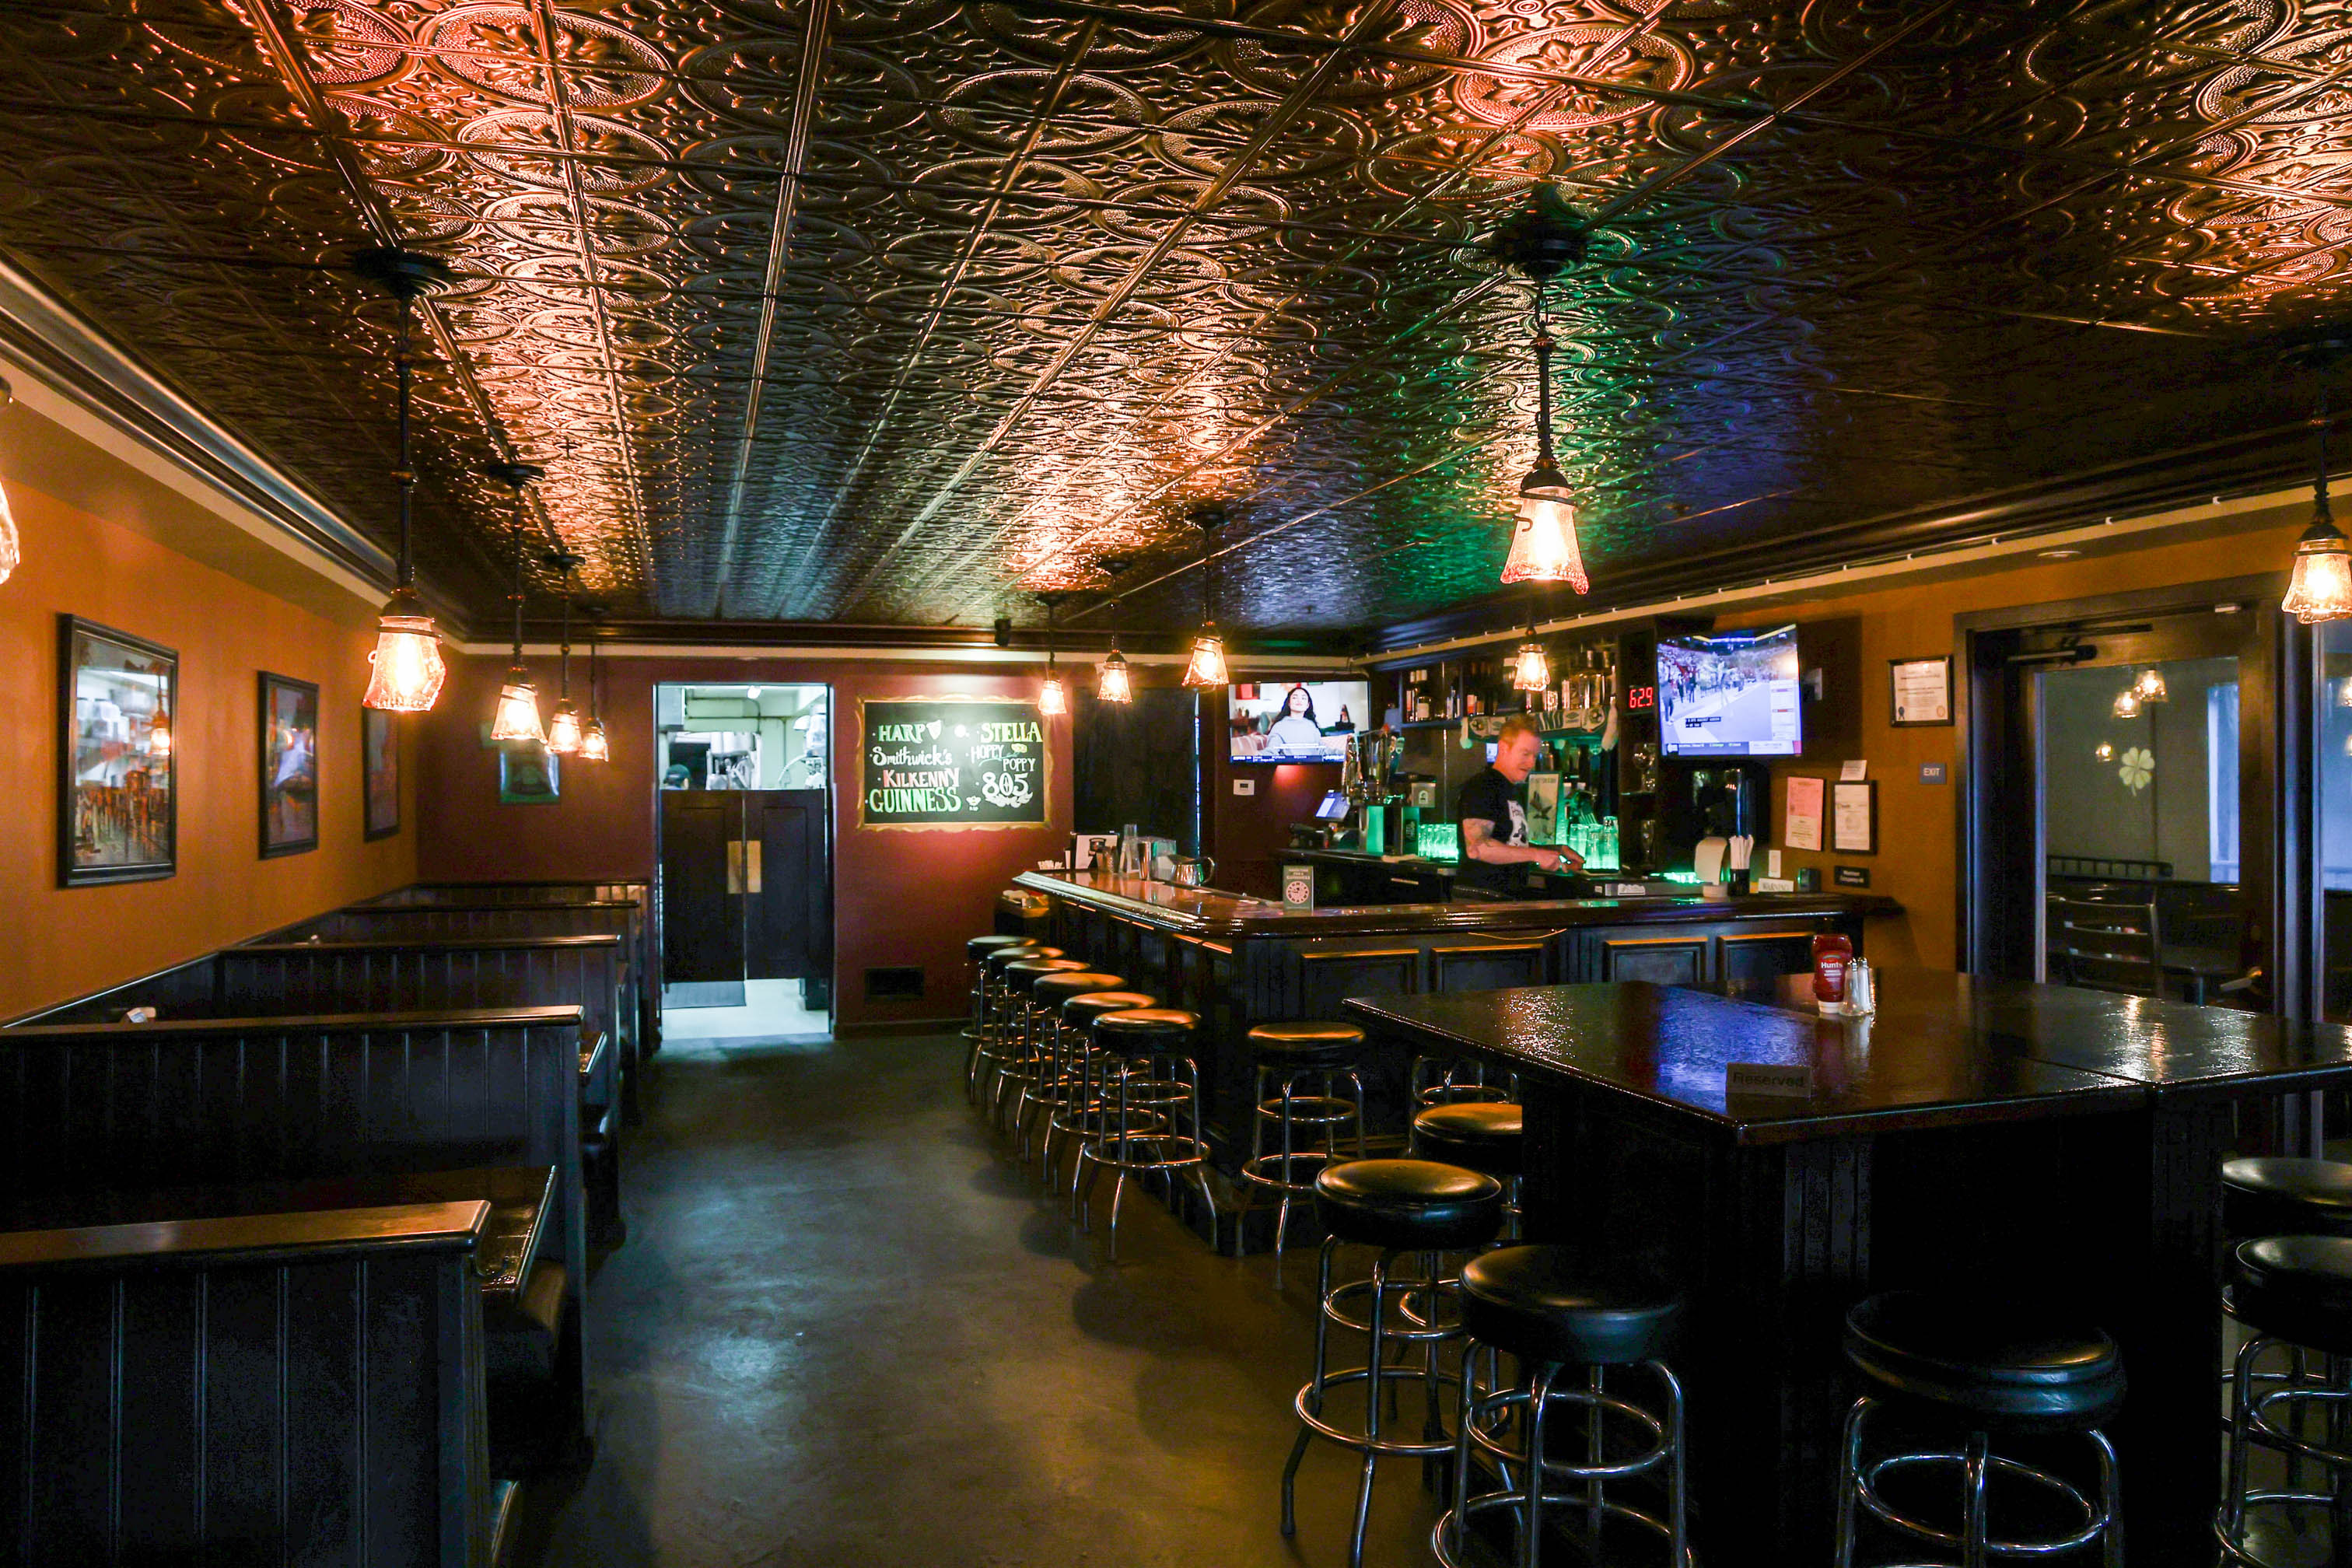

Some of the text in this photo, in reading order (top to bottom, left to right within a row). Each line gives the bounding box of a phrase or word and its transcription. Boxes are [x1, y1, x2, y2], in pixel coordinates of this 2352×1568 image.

[878, 724, 926, 744] HARP
[981, 722, 1043, 743] STELLA
[873, 745, 952, 766] Smithwick's
[971, 744, 1004, 764] HOPPY
[1003, 758, 1036, 772] POPPY
[1923, 768, 1941, 776] EXIT
[982, 772, 1029, 796] 805
[870, 786, 962, 813] GUINNESS
